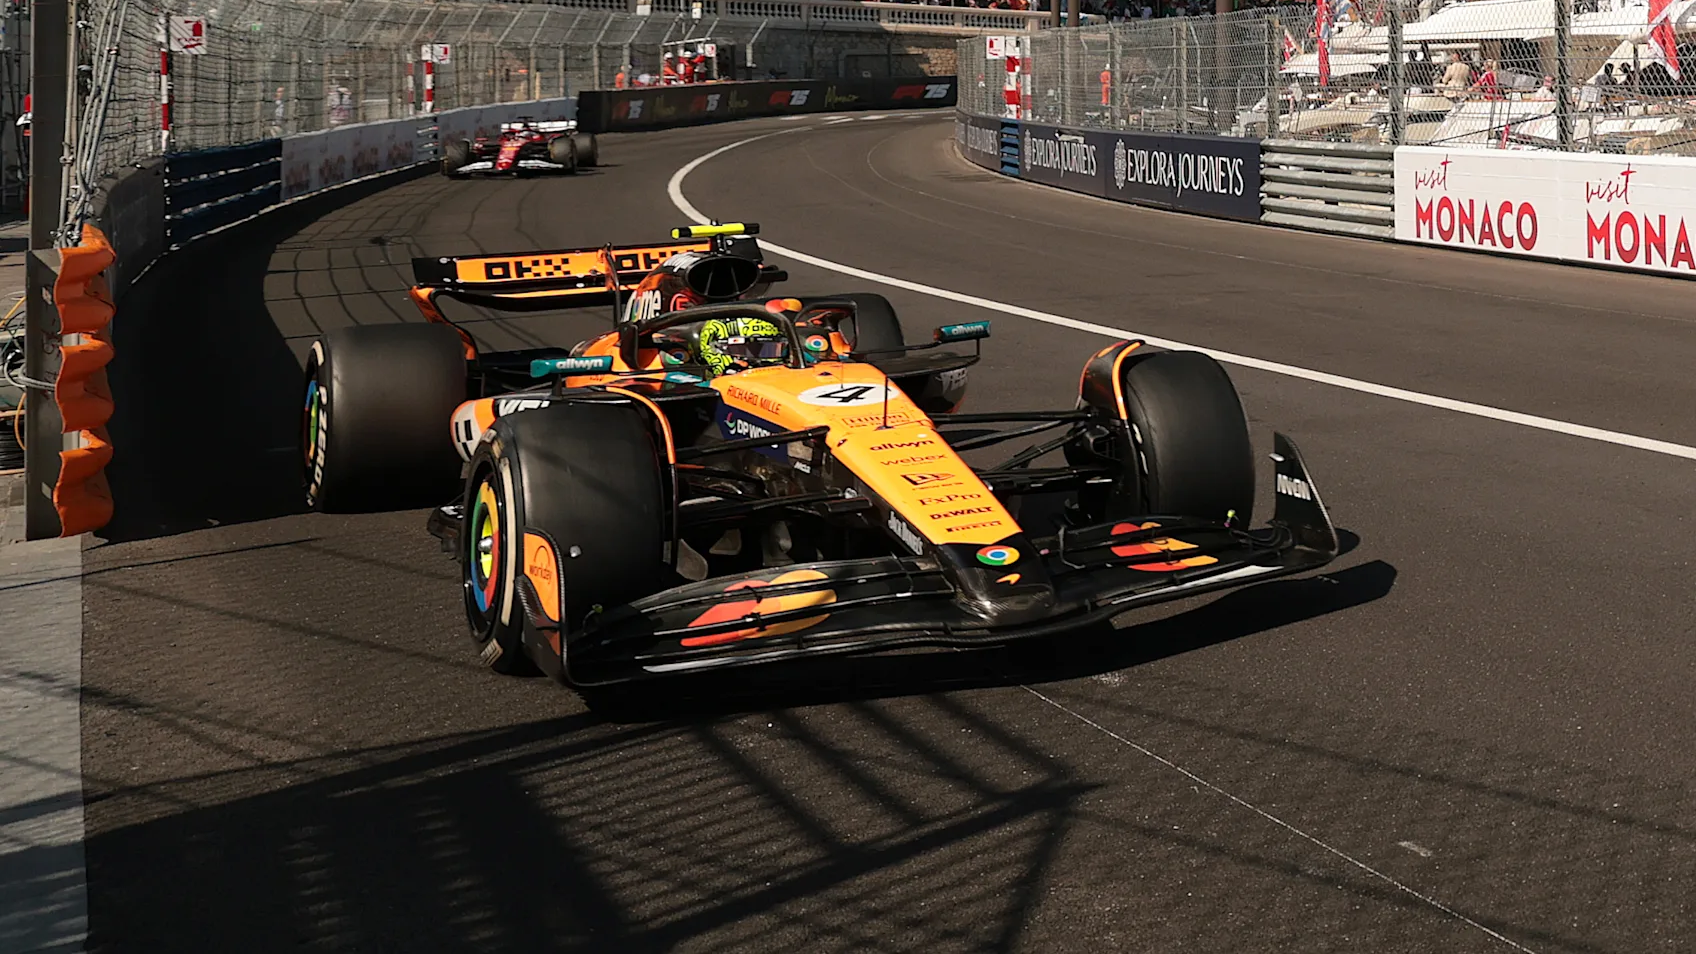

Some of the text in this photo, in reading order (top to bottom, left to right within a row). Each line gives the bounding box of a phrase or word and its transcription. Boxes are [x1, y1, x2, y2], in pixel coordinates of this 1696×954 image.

[1031, 138, 1061, 169] EXPLORA
[1060, 141, 1096, 178] JOURNEYS
[1127, 148, 1244, 198] EXPLORA JOURNEYS
[1414, 153, 1452, 191] visit
[1585, 163, 1636, 204] visit
[1415, 196, 1538, 251] MONACO
[952, 325, 985, 335] allwyn
[556, 357, 603, 370] allwyn
[727, 385, 782, 416] RICHARD MILLE
[816, 386, 876, 399] 4
[314, 386, 327, 487] P ZERO
[737, 419, 749, 435] DP
[870, 440, 934, 451] allwyn
[881, 455, 947, 465] webex
[917, 494, 981, 506] FxPro
